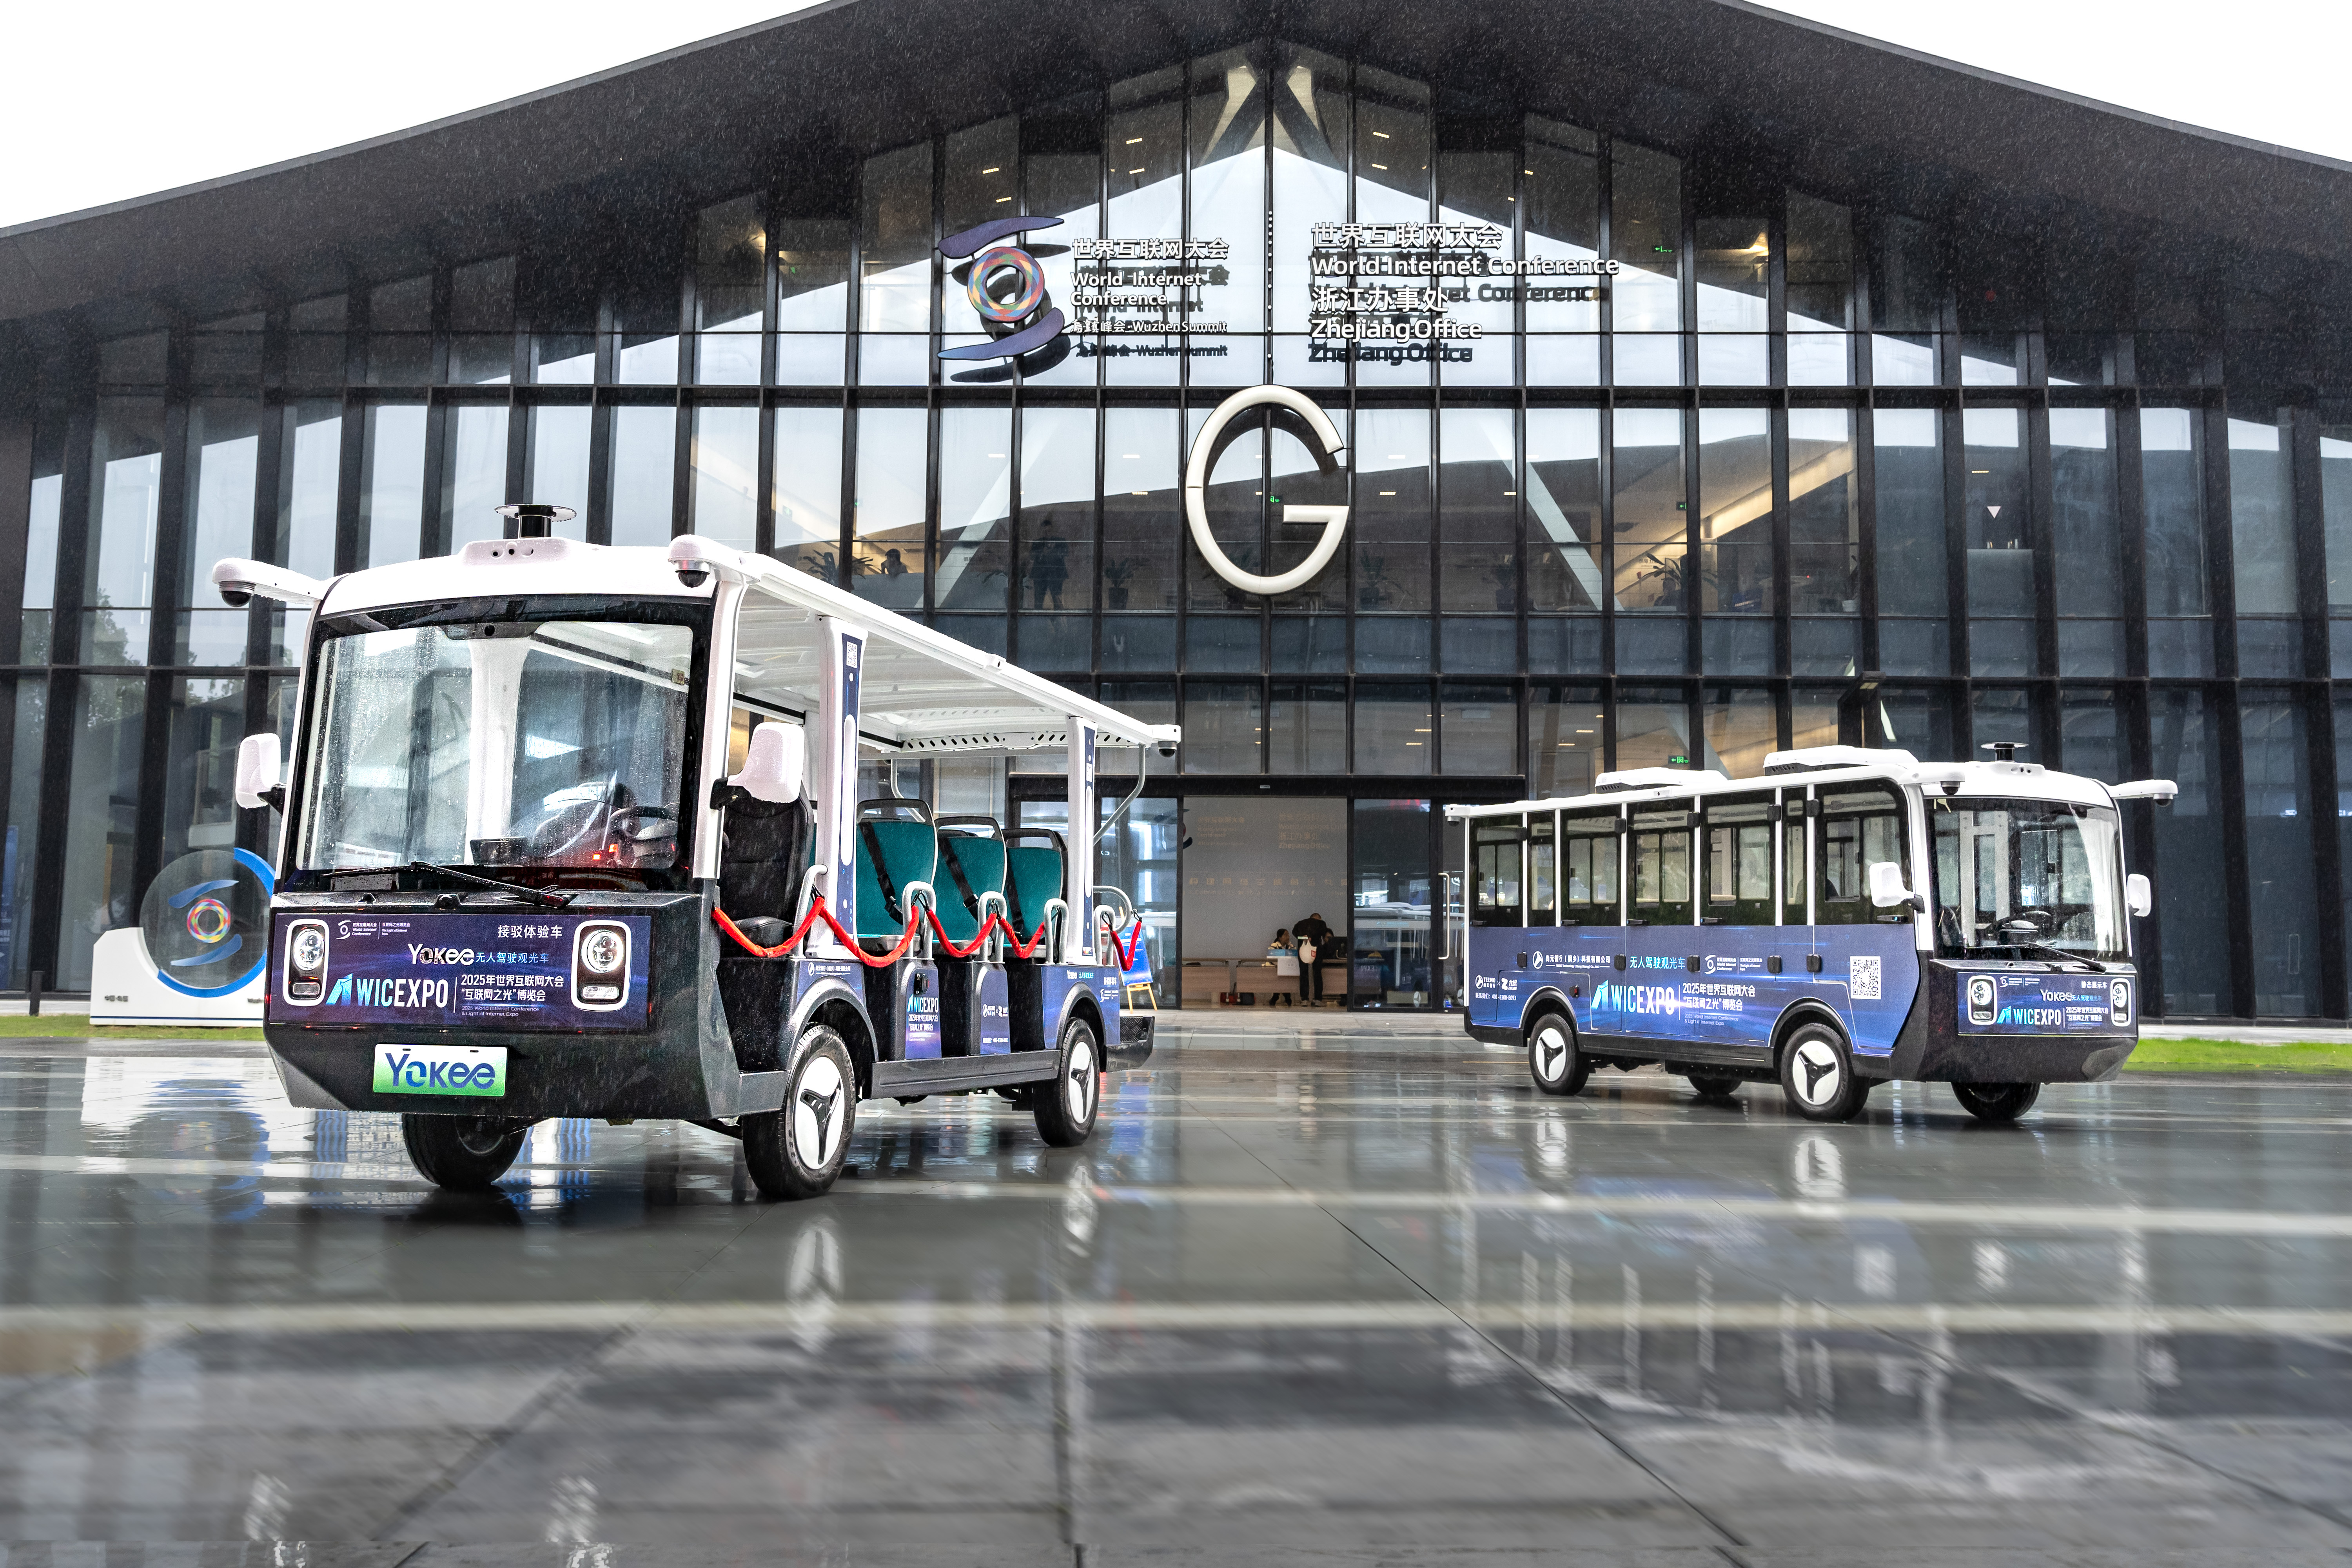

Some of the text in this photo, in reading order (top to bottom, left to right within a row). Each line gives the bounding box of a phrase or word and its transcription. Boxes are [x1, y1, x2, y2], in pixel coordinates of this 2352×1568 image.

[1311, 222, 1504, 249] 世界互联网大会
[1072, 238, 1229, 260] 世界互联网大会
[1311, 255, 1619, 277] World Internet Conference
[1070, 271, 1202, 287] World Internet
[1070, 290, 1168, 307] Conference
[1311, 286, 1449, 314] 浙江办事处
[1181, 321, 1227, 333] Summit
[1311, 318, 1483, 343] Zhejiang Office
[497, 924, 563, 938] 接驳体验车
[407, 943, 475, 965] Yokee
[475, 952, 549, 964] 无人驾驶观光车
[1630, 956, 1686, 969] 无人驾驶观光车
[461, 974, 564, 987] 2025年世界互联网大会
[357, 978, 448, 1008] WICEXPO
[1682, 983, 1755, 997] 2025年世界互联网大会
[2040, 989, 2072, 1002] Yokee
[913, 997, 939, 1013] WICEXPO
[1611, 985, 1674, 1015] WICEXPO
[2013, 1008, 2061, 1025] WICEXPO
[385, 1053, 496, 1089] Yokee
